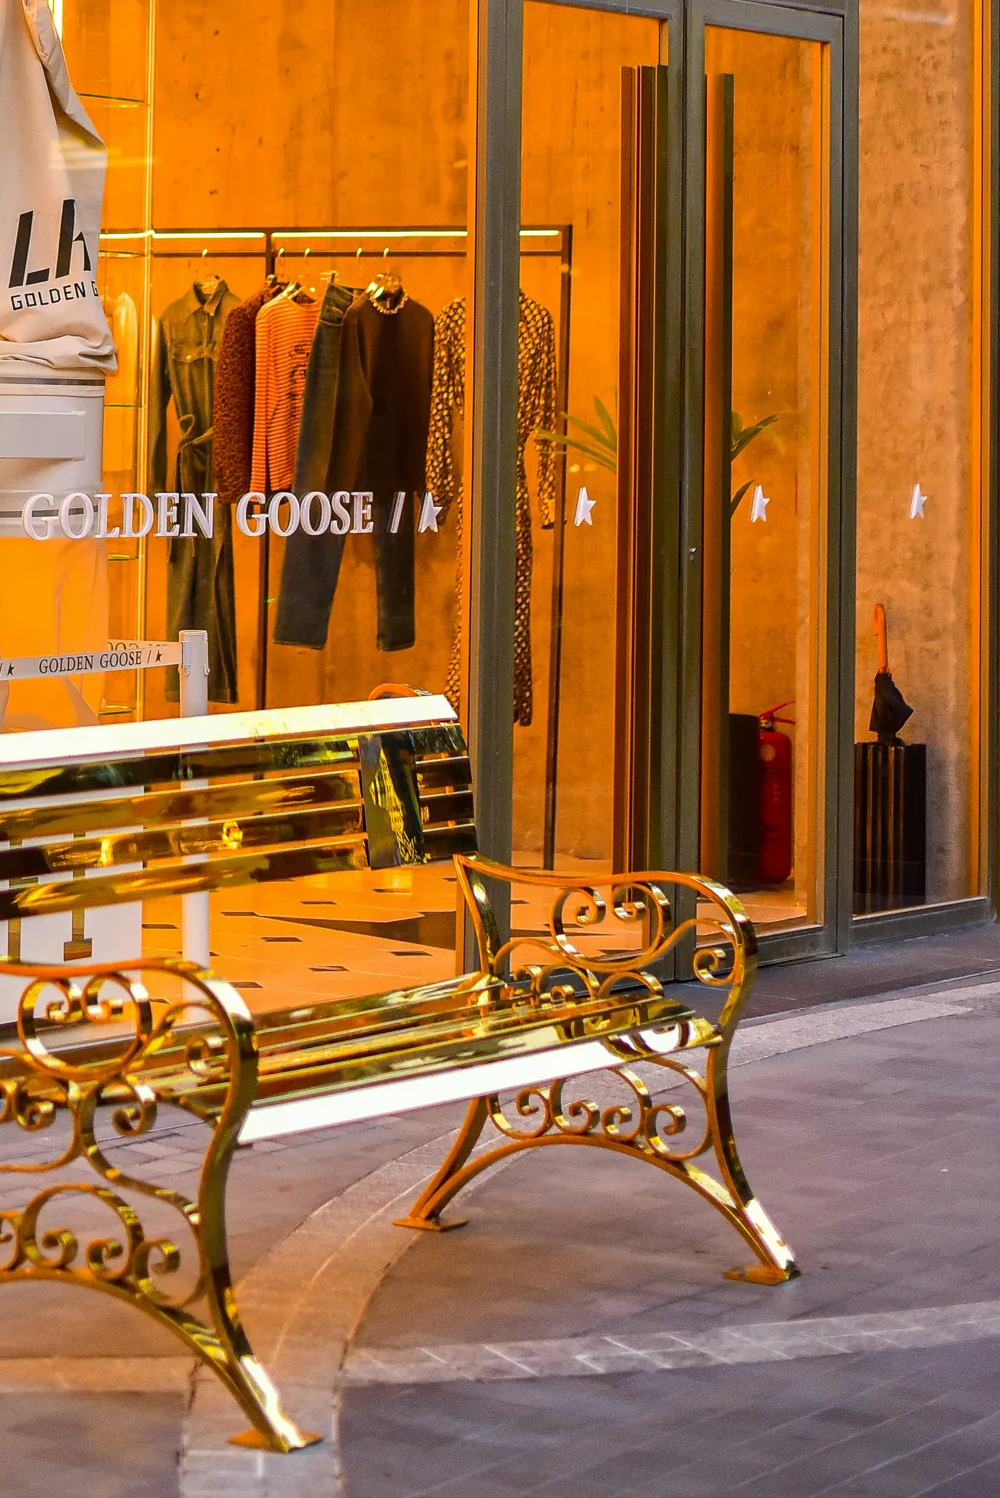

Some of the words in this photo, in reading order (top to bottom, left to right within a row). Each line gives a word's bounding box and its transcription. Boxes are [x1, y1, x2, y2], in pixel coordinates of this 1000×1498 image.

[10, 281, 87, 311] GOLDEN
[21, 491, 218, 540] GOLDEN
[236, 490, 375, 538] GOOSE
[38, 653, 94, 674] GOLDEN
[99, 650, 142, 669] GOOSE
